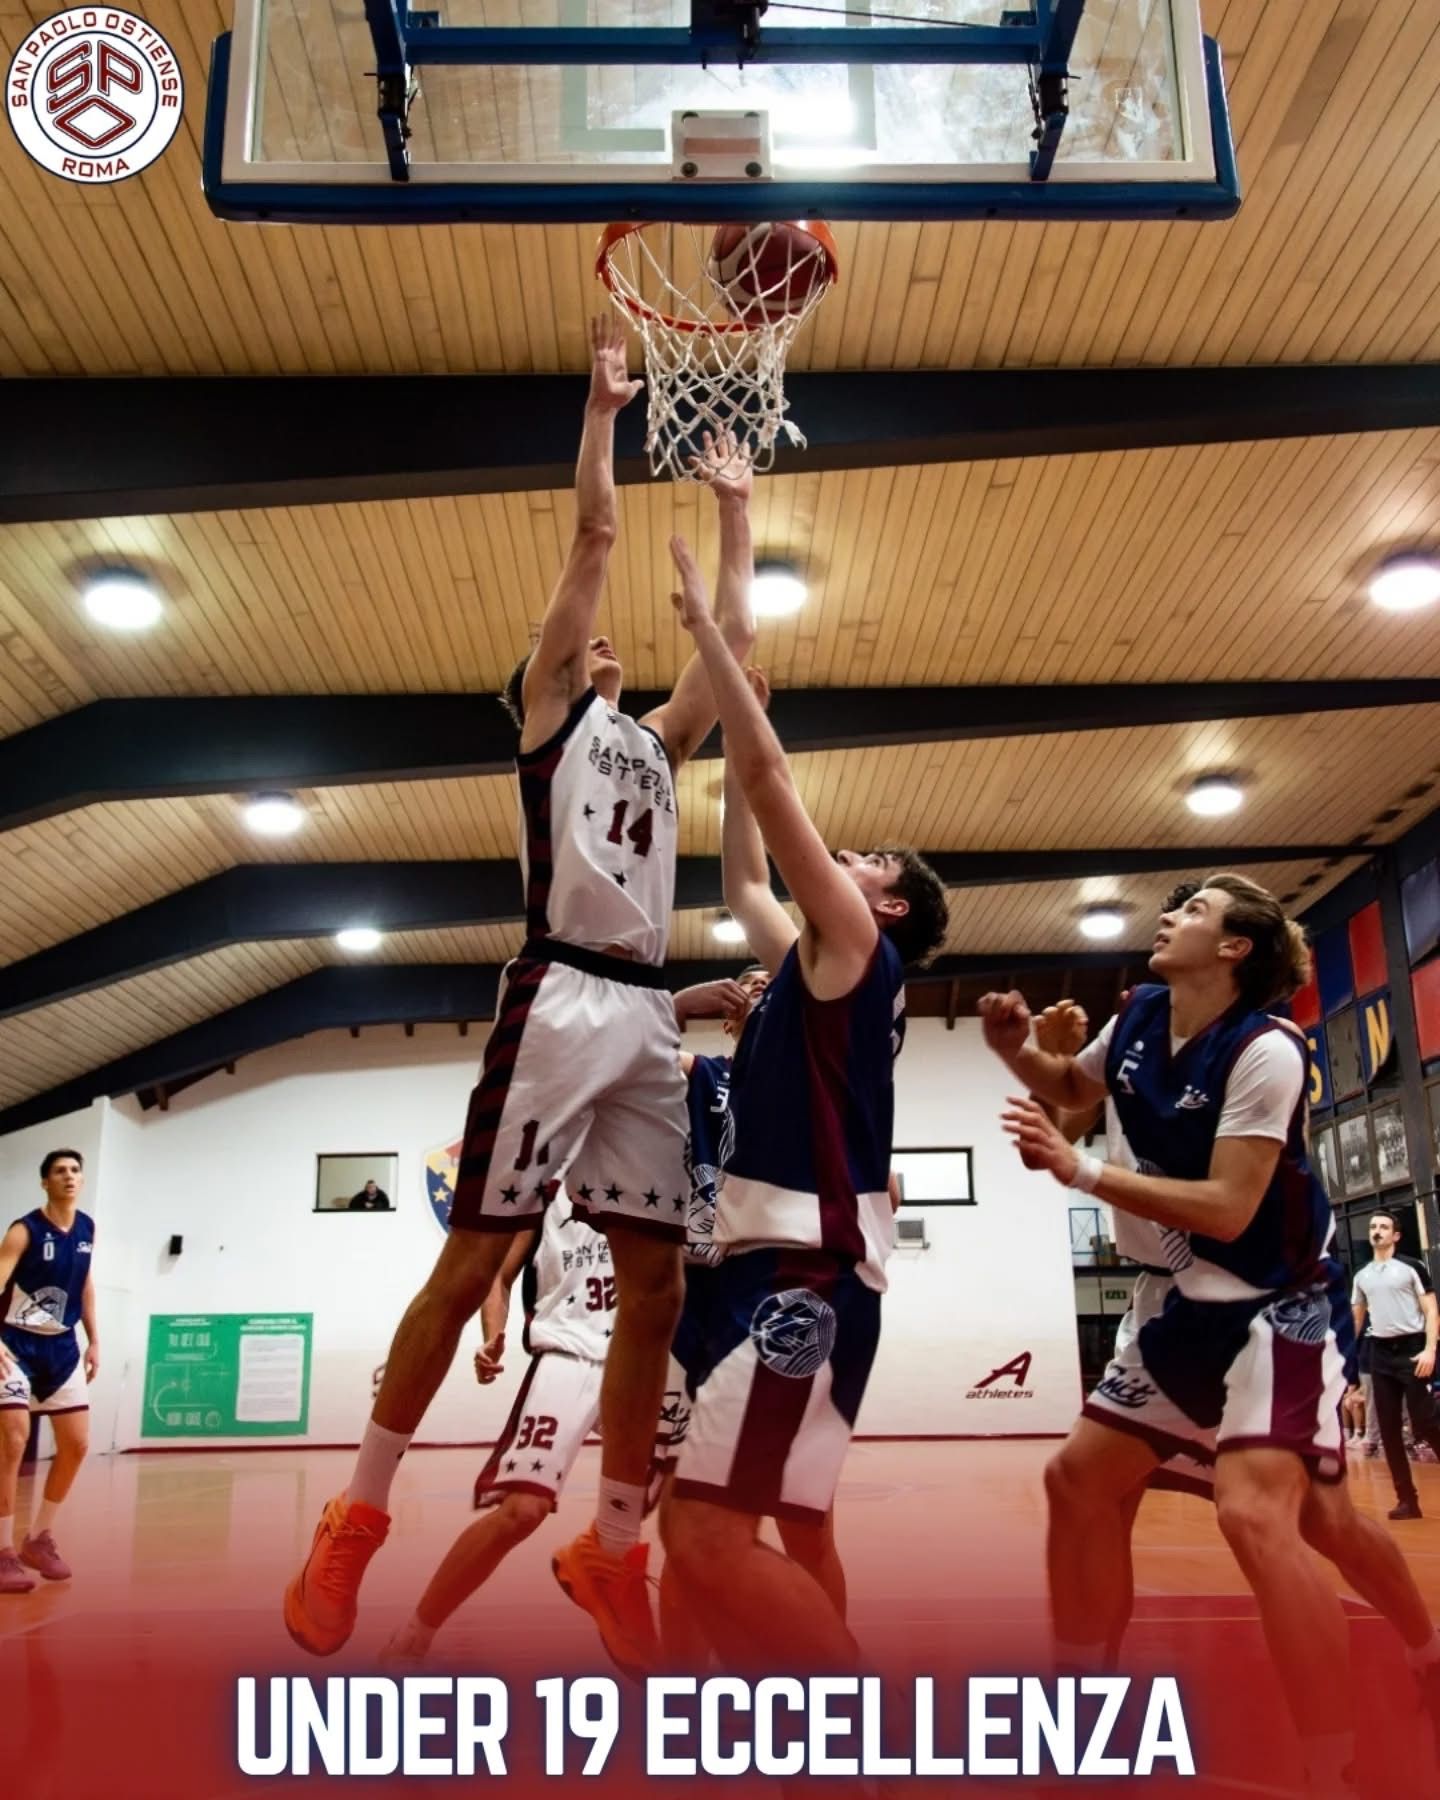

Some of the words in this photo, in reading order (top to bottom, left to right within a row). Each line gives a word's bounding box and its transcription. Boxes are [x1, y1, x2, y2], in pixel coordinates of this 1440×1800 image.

[606, 799, 654, 858] 14
[43, 1241, 55, 1261] 0
[585, 1276, 618, 1312] 32
[965, 1388, 1034, 1400] athletes
[515, 1415, 559, 1451] 32
